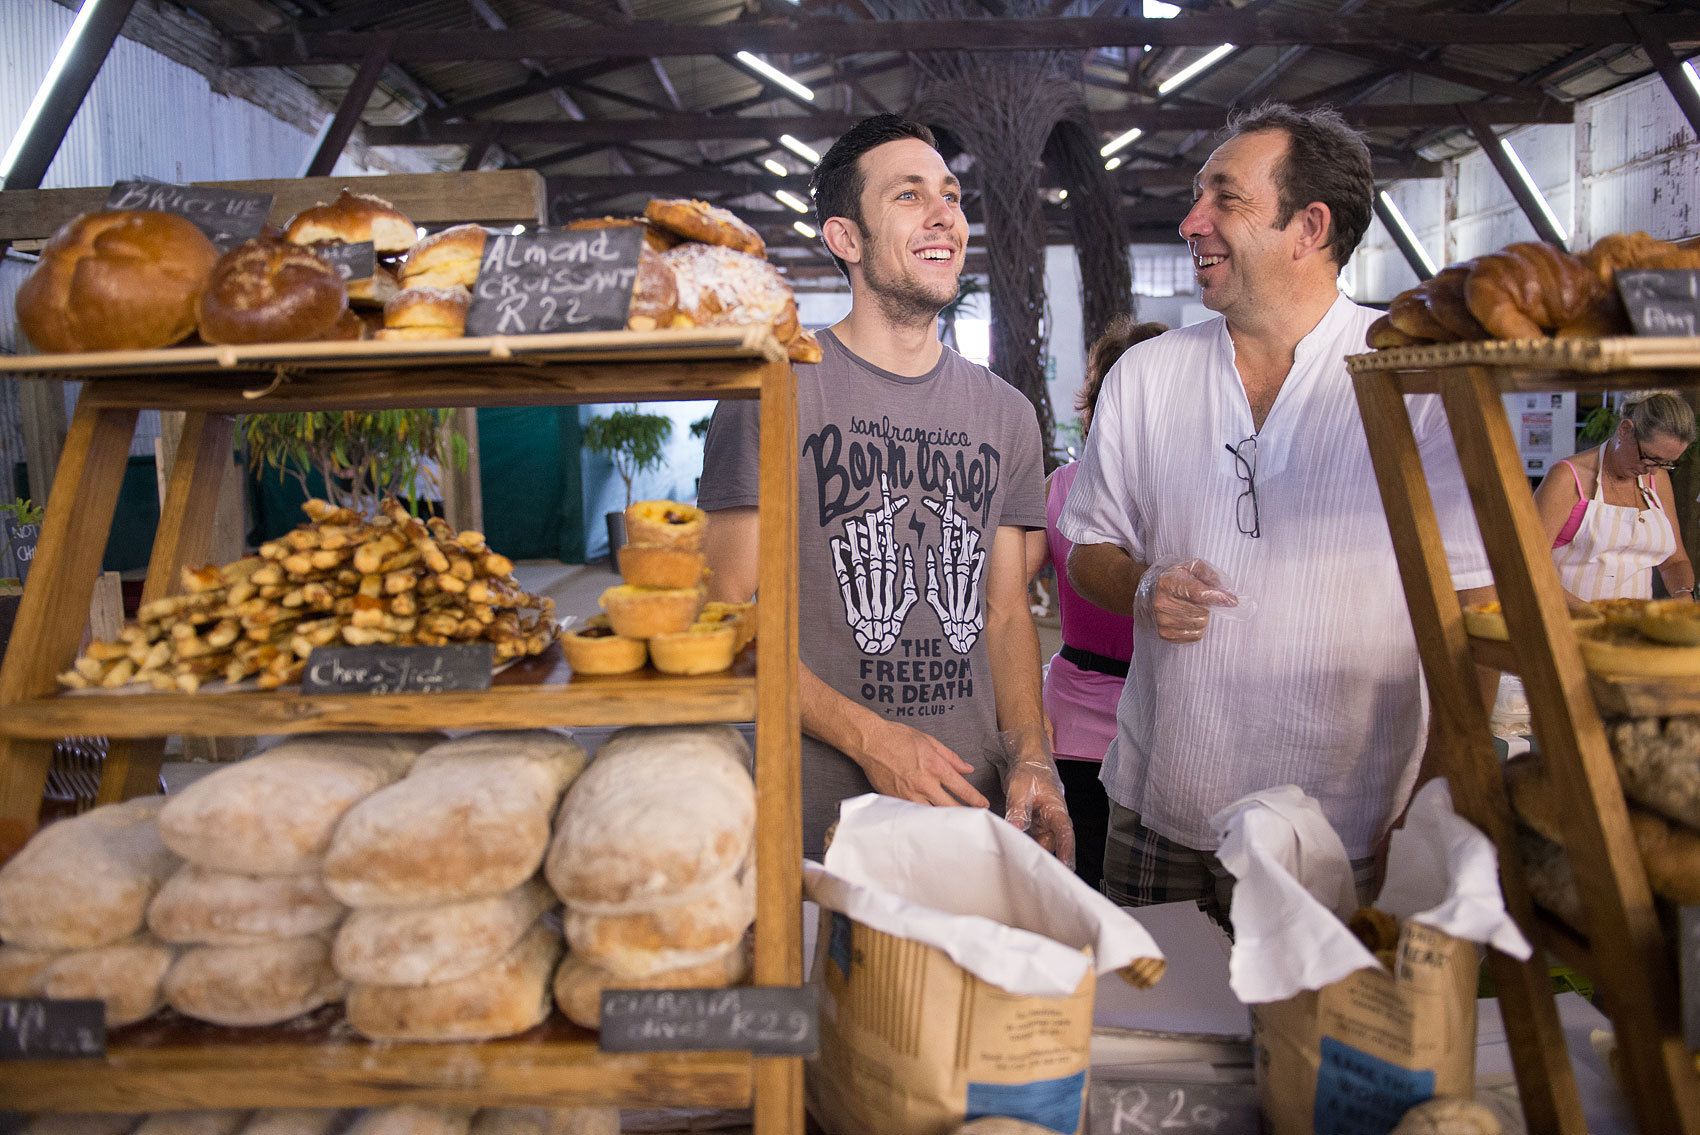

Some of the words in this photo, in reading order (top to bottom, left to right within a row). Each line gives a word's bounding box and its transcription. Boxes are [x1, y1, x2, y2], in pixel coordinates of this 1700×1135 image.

[802, 424, 914, 527] Born
[901, 638, 942, 657] THE
[860, 658, 973, 682] FREEDOM
[861, 683, 894, 703] OR
[902, 678, 973, 703] DEATH
[896, 706, 914, 716] MC
[918, 704, 945, 716] CLUB
